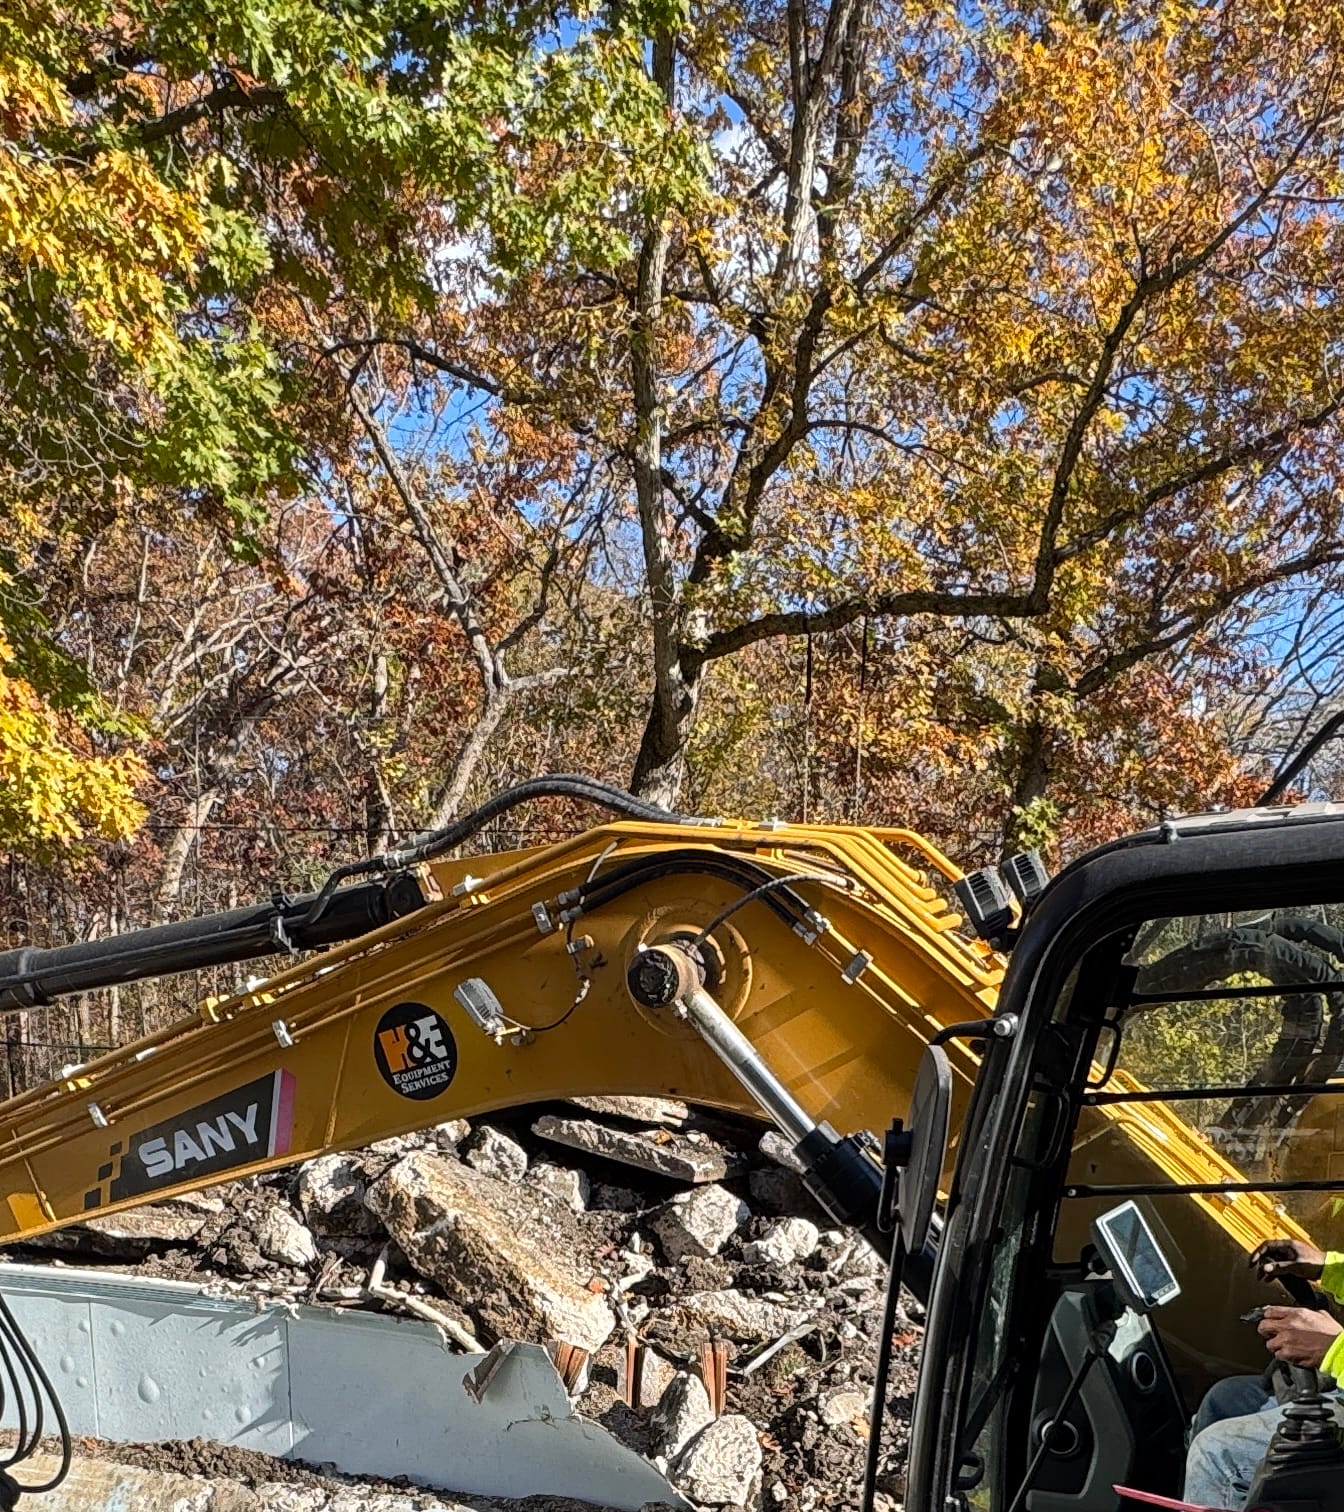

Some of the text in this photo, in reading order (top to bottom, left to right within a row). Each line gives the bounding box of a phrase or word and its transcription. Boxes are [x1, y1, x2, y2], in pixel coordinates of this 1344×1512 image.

[378, 1014, 448, 1074] H&E
[392, 1060, 451, 1085] EQUIPMENT
[400, 1071, 450, 1094] SERVICES
[138, 1103, 258, 1178] SANY
